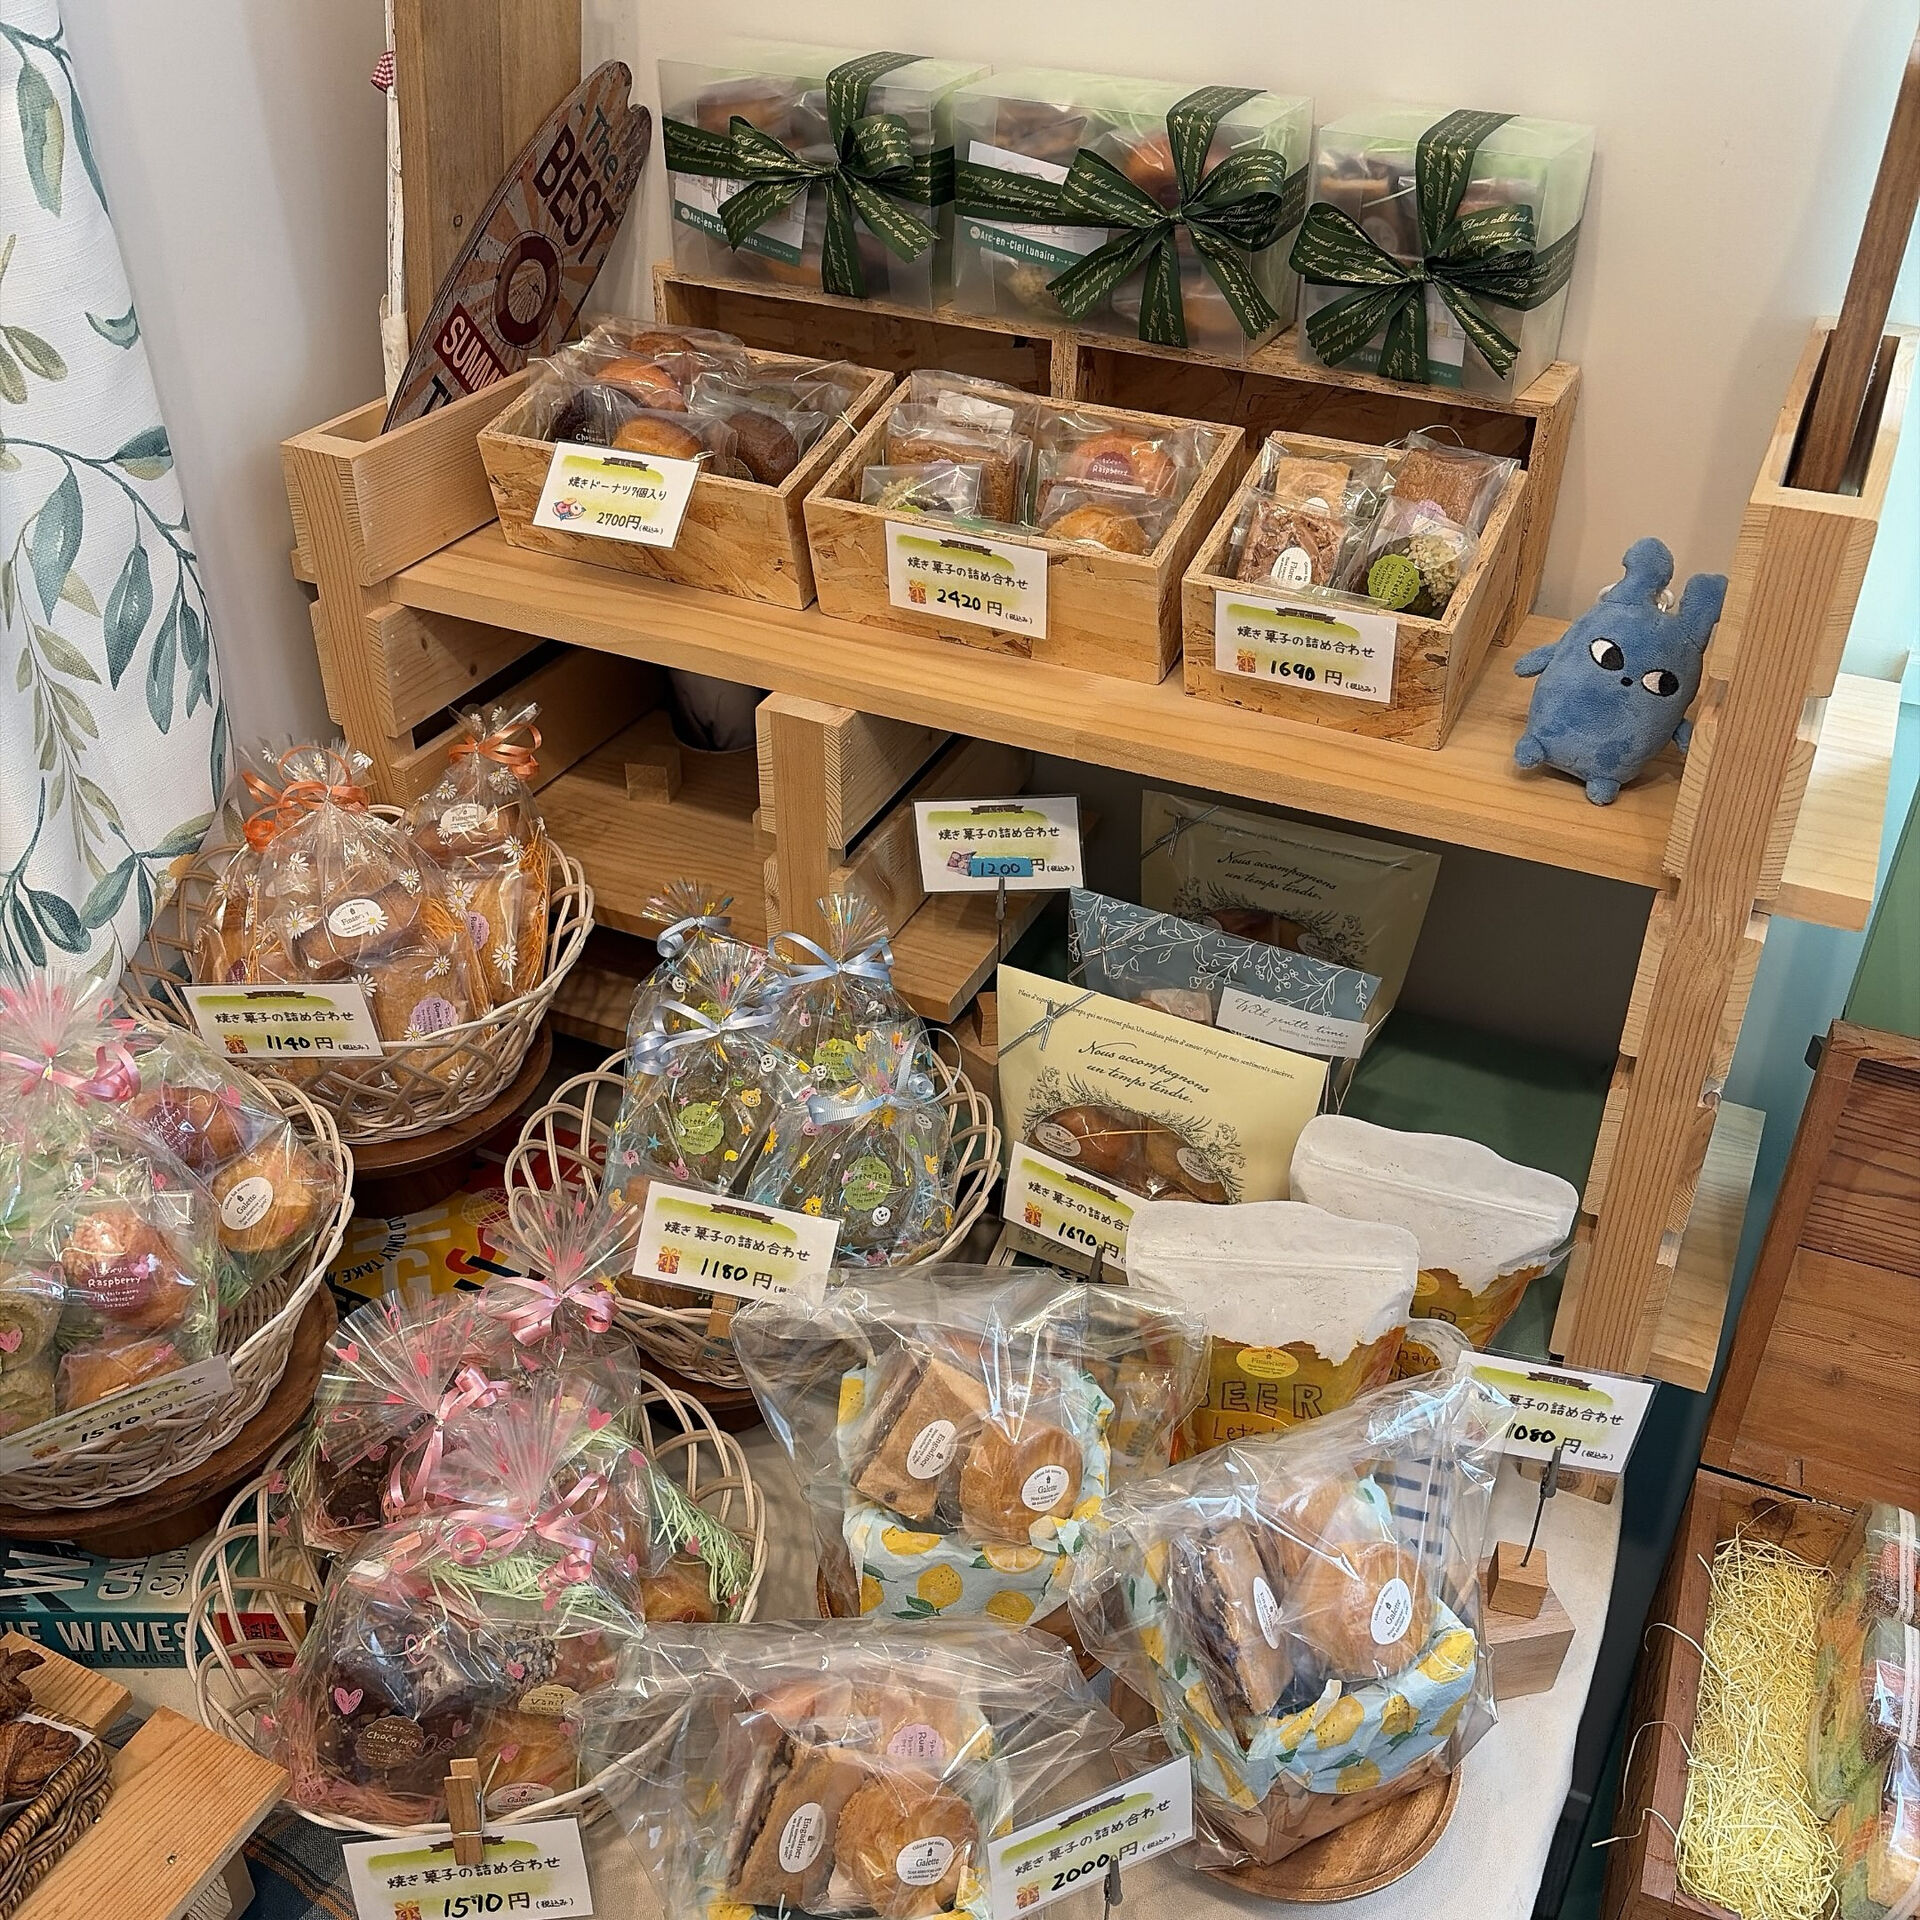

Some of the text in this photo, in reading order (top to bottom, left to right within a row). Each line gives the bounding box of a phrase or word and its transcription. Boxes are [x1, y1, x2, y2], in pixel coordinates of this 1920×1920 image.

[532, 123, 617, 265] BEST
[689, 211, 727, 236] Arc-en-Cie
[980, 231, 1056, 262] Arc-en-Ciel Lunaire
[567, 476, 668, 502] 焼きドーナツ7個入り
[596, 510, 641, 531] 2700円
[907, 556, 1029, 591] 焼き菓子の詰め合わせ
[1237, 625, 1375, 660] 焼き菓子の詰め合わせ
[938, 826, 1060, 841] 焼き菓子の詰め合わせ
[981, 862, 1020, 875] 1200
[1225, 872, 1241, 880] un
[1244, 872, 1279, 890] temps
[1254, 861, 1336, 889] accompagnons
[215, 1011, 354, 1025] 焼き菓子の詰め合わせ
[1265, 1014, 1311, 1032] gentle
[1078, 1040, 1210, 1093] Nous accompagnons
[1086, 1065, 1193, 1103] un temps tendre.
[1027, 1180, 1130, 1233] 焼き菓子の詰め合
[379, 1234, 407, 1261] ONLY
[664, 1221, 811, 1262] 焼き菓子の詰め合わせ
[87, 1275, 142, 1289] Raspberry
[342, 1260, 384, 1283] TAKE
[920, 1434, 947, 1469] Engadiner
[56, 1621, 199, 1652] WAVES
[366, 1730, 420, 1749] Choco nuts
[795, 1818, 813, 1860] Engadiner
[1015, 1799, 1172, 1877] 焼き菓子の詰め合わせ
[387, 1857, 561, 1890] 焼き菓子の詰め合わせ
[915, 1857, 941, 1868] Galette
[1051, 1853, 1110, 1891] 2000
